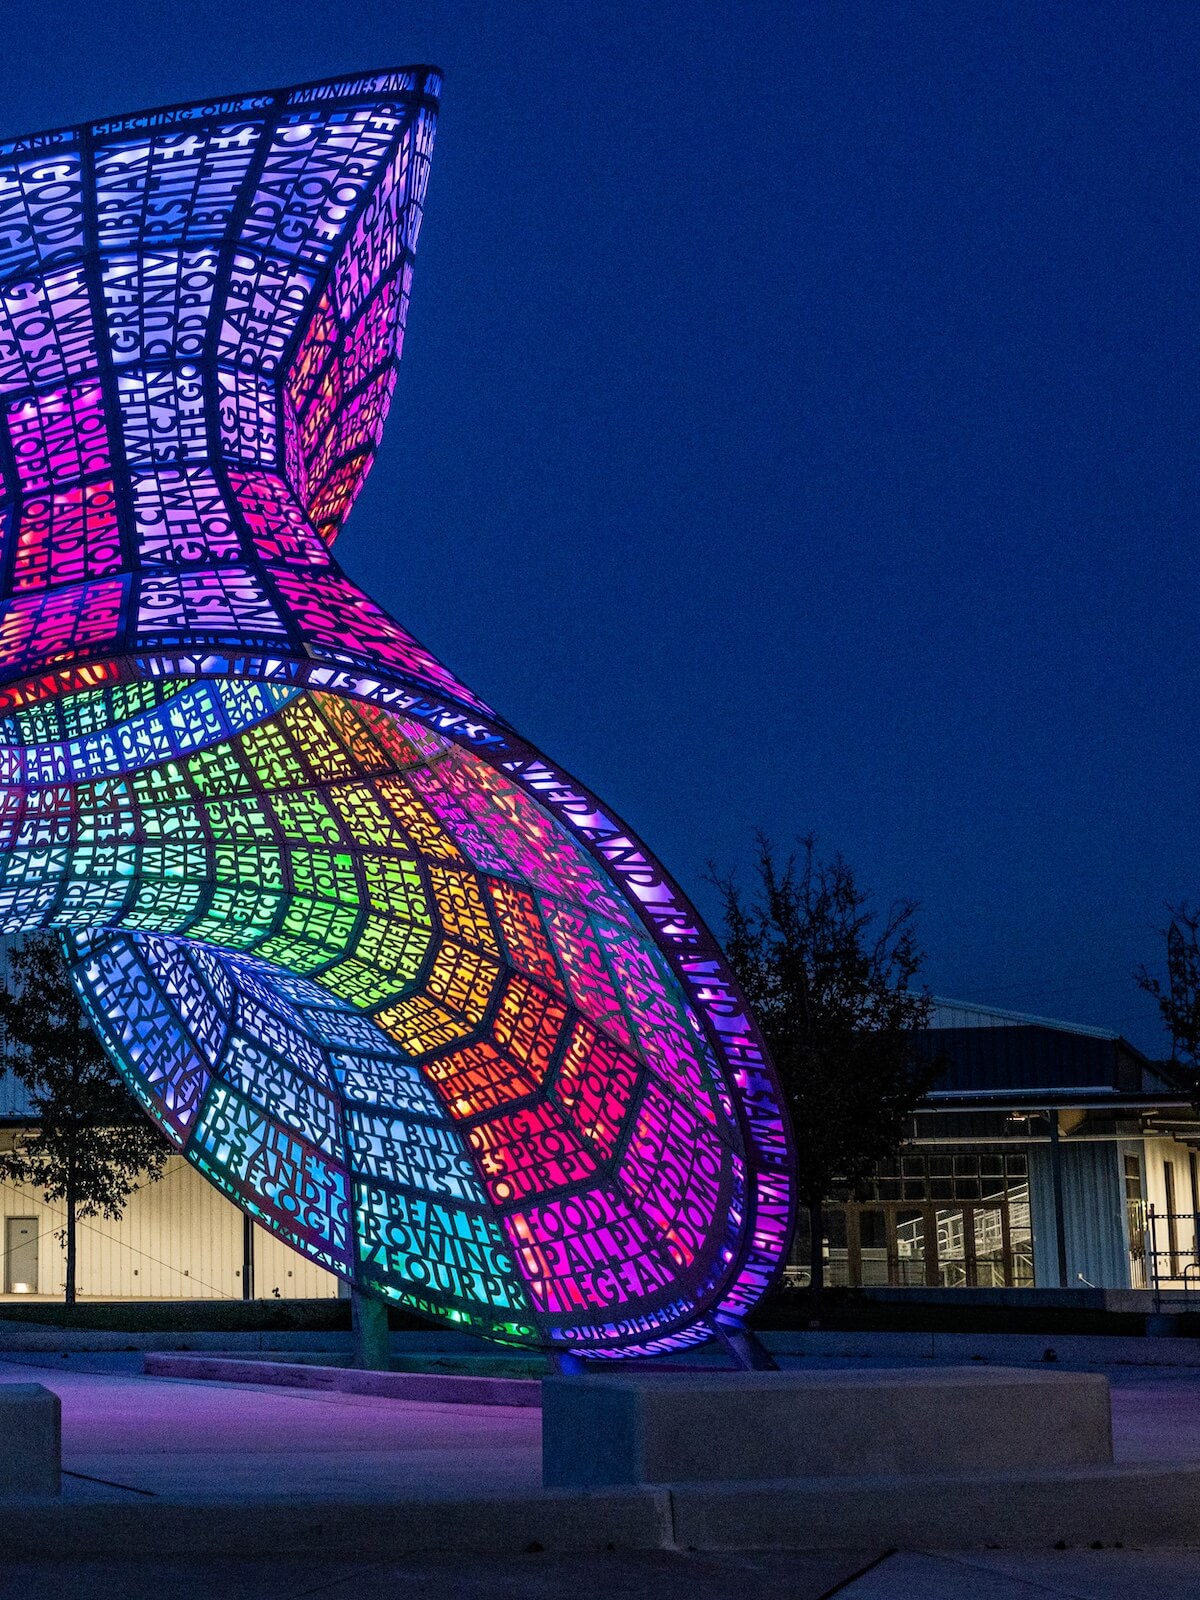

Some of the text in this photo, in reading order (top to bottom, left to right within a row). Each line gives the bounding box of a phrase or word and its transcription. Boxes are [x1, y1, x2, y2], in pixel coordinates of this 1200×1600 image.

[12, 132, 65, 152] AND
[200, 99, 241, 118] OUR
[21, 160, 84, 246] GOOD
[96, 142, 150, 249] LIBRARY
[9, 301, 54, 343] TO
[101, 258, 140, 355] GREAT
[51, 302, 99, 375] WITH
[120, 387, 152, 466] WITH
[181, 400, 208, 457] THE
[13, 420, 50, 494] HOPE
[128, 470, 164, 528] CITY
[533, 998, 569, 1062] OKAY
[354, 1055, 414, 1081] WHO
[491, 1167, 555, 1203] OUR
[756, 1172, 790, 1224] WAY
[252, 1151, 321, 1203] AND
[523, 1239, 566, 1279] UP
[529, 1190, 610, 1244] FOOD
[741, 1226, 785, 1278] THAT
[404, 1257, 480, 1303] OUR
[721, 1274, 769, 1314] WE
[561, 1324, 608, 1341] OUR
